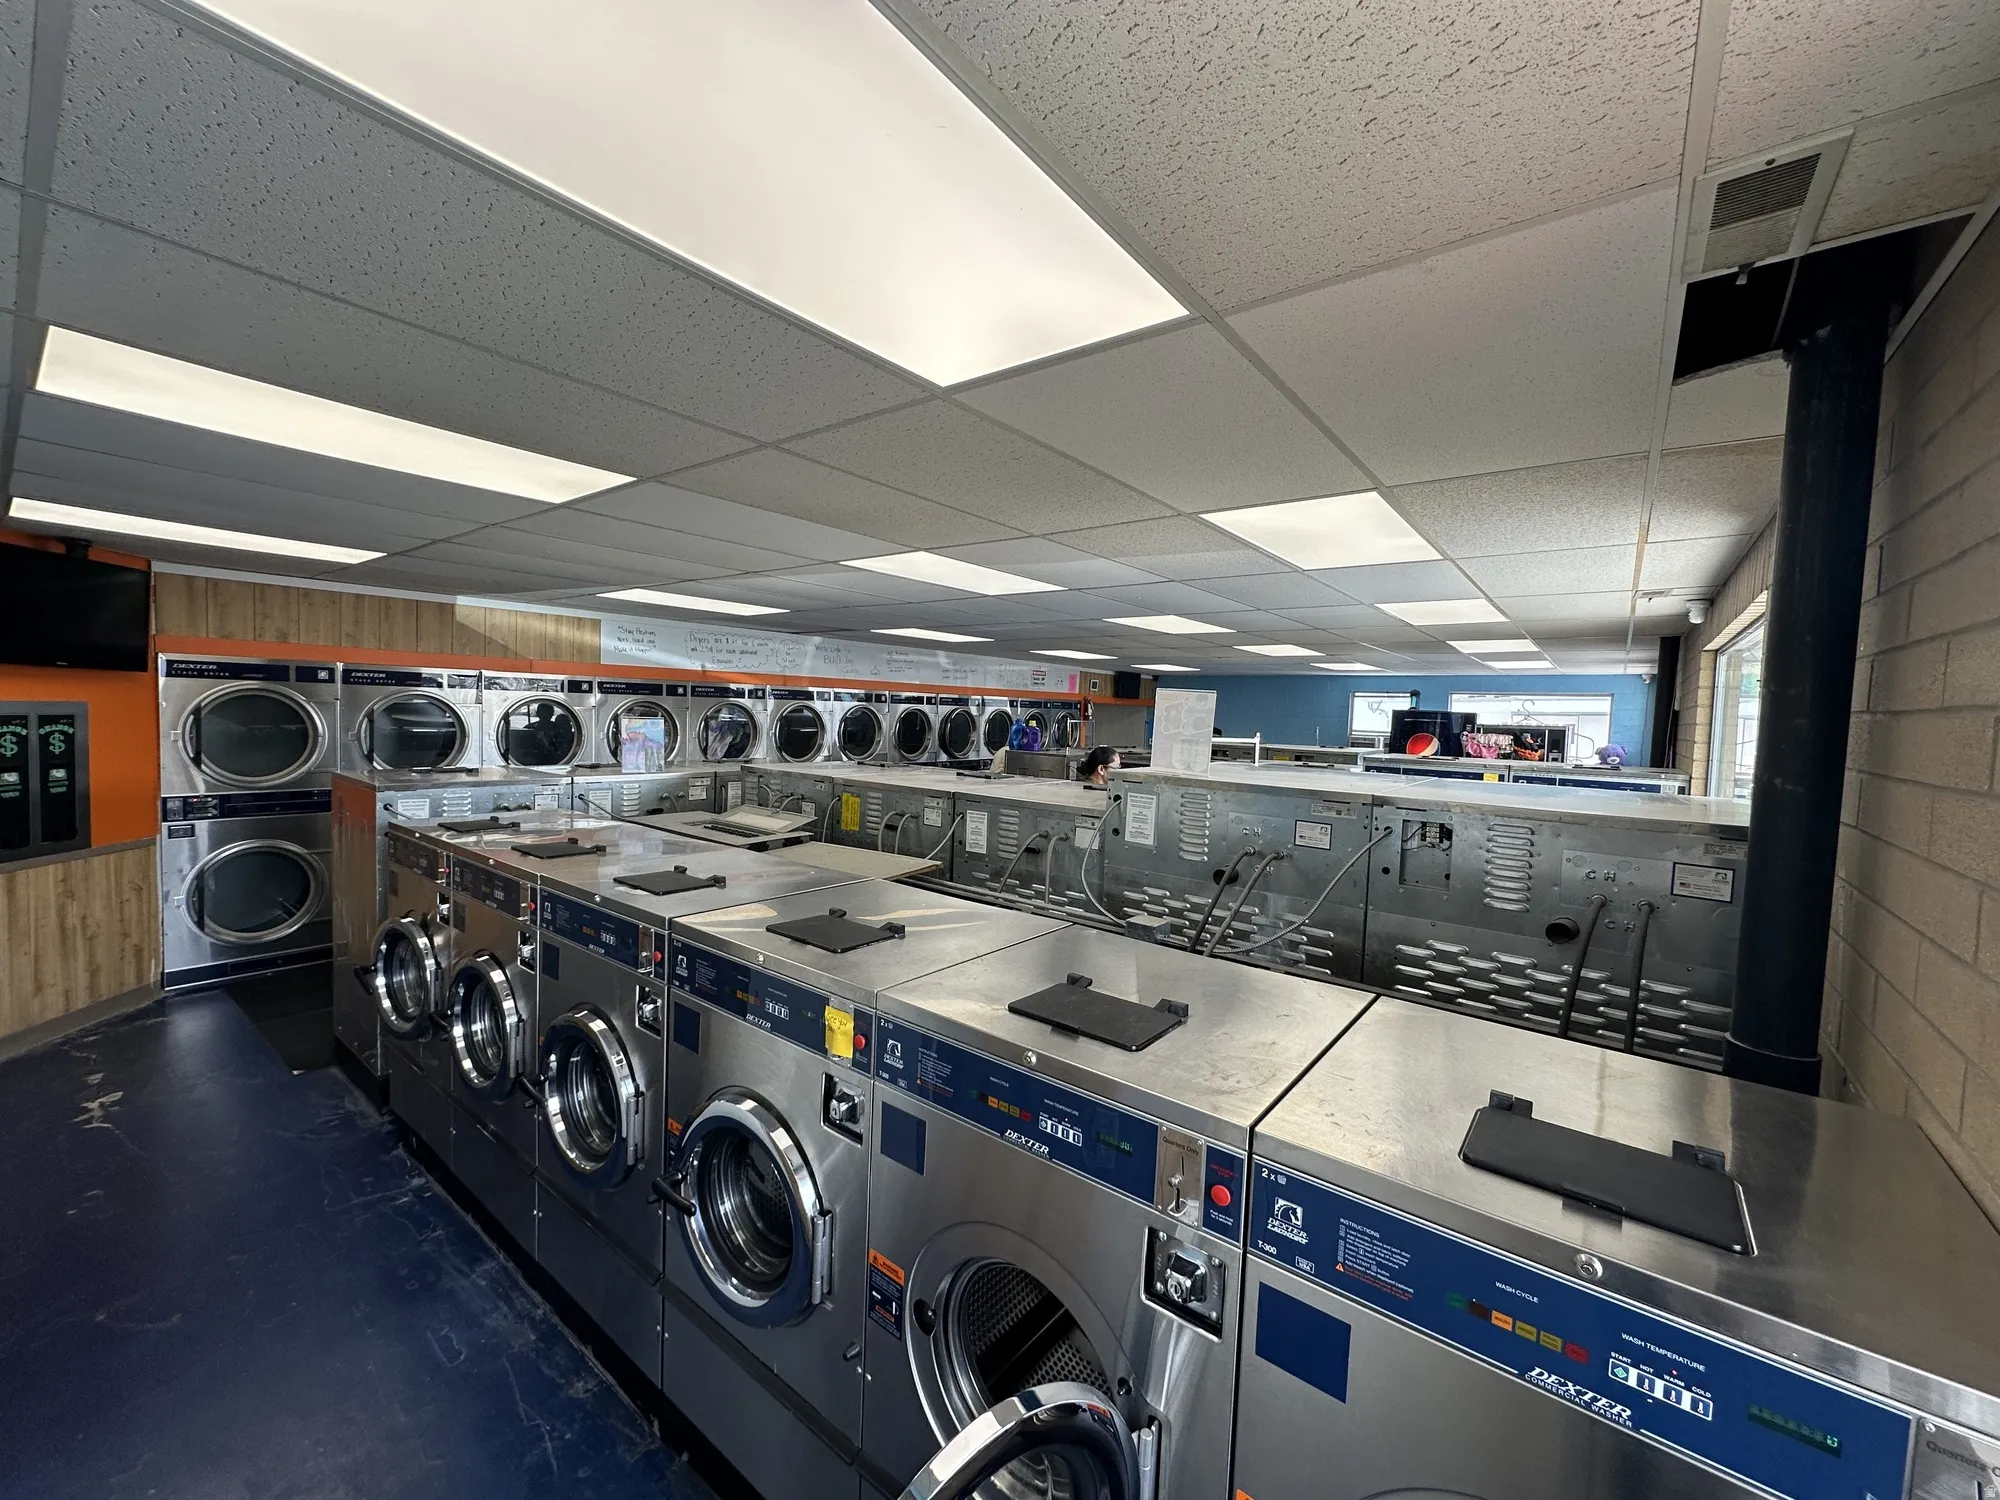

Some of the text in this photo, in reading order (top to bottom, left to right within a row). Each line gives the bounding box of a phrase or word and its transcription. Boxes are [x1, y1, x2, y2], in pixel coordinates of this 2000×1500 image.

[39, 724, 74, 734] CHANGE
[1004, 1129, 1050, 1155] DEXTER
[1162, 1136, 1199, 1156] Quarters Only
[1261, 1168, 1268, 1178] 2
[1267, 1224, 1309, 1245] LAUNDRY
[1268, 1217, 1308, 1239] DEXTER
[1340, 1218, 1380, 1238] INSTRUCTIONS
[1257, 1240, 1276, 1255] T-300
[1496, 1281, 1539, 1304] WASH CYCLE
[1611, 1351, 1631, 1364] START
[1621, 1333, 1706, 1372] WASH TEMPERATURE
[1639, 1364, 1654, 1373] HOT
[1663, 1374, 1685, 1387] WARM
[1525, 1374, 1632, 1428] COMMERCIAL WASHER
[1528, 1366, 1632, 1420] DEXTER
[1692, 1386, 1712, 1398] COLD
[1926, 1440, 1987, 1472] Quarters
